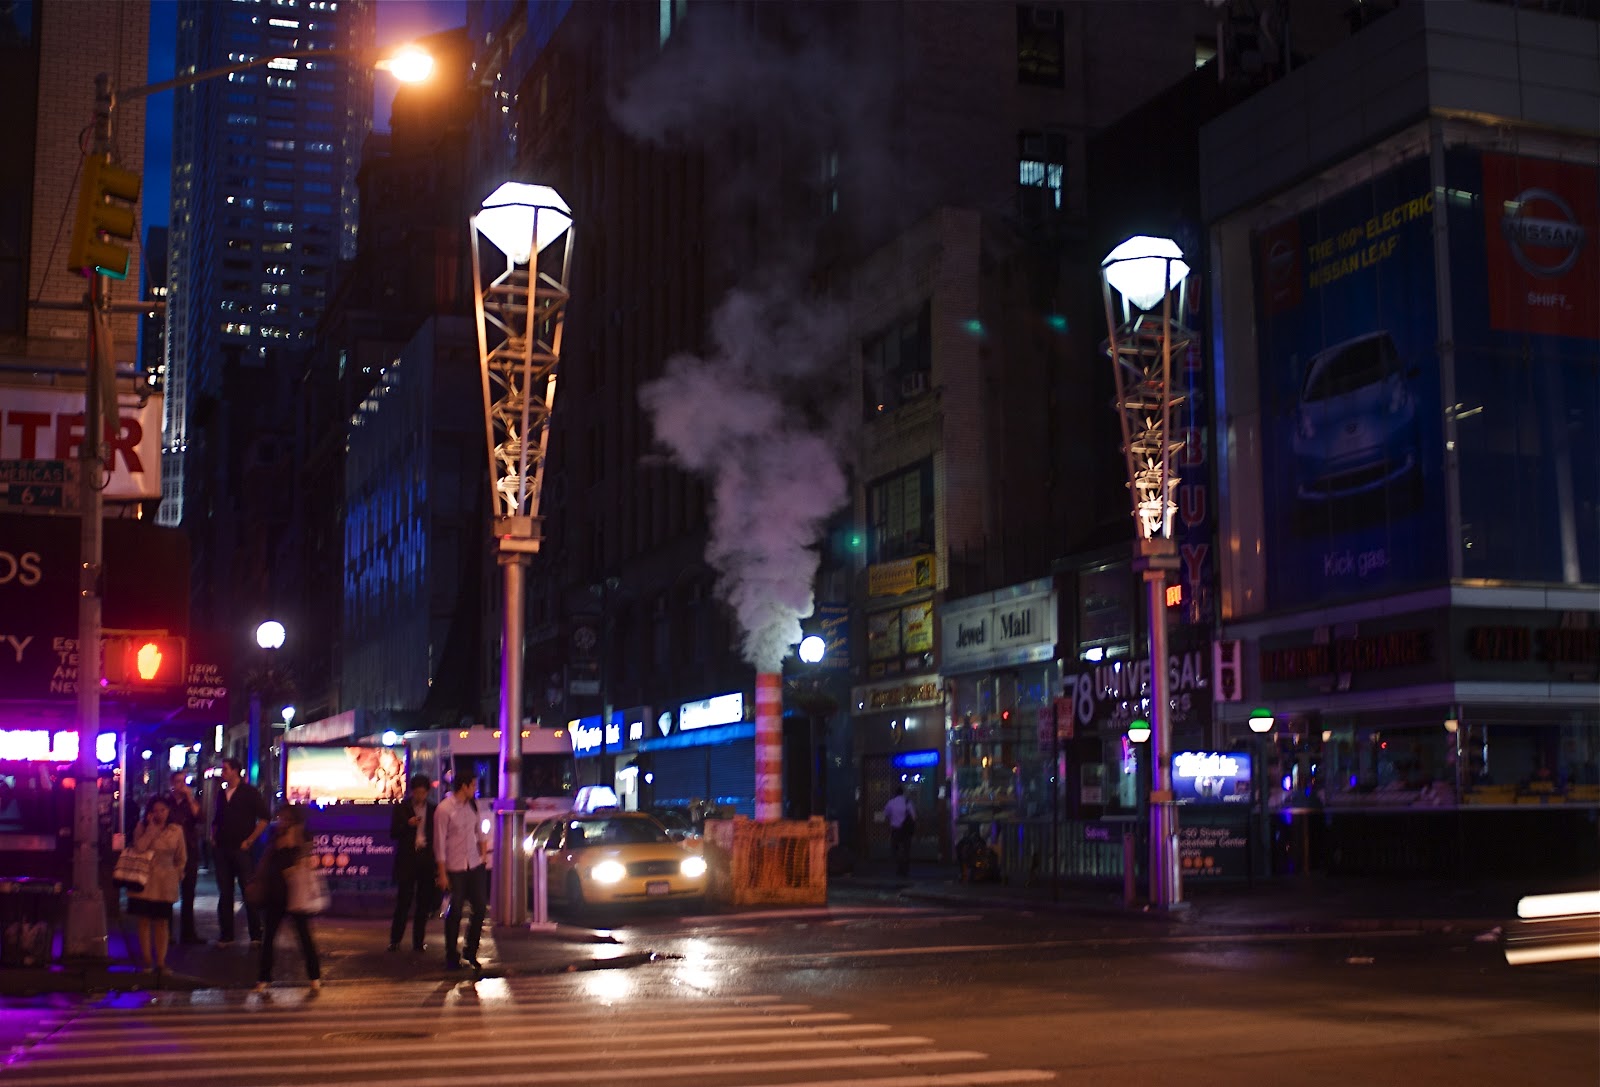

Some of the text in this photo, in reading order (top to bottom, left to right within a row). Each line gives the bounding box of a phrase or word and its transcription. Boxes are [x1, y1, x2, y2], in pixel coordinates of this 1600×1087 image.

[1308, 239, 1334, 265] THE
[1366, 191, 1434, 240] ELECTRIC
[1503, 221, 1580, 245] NISSAN
[1309, 234, 1399, 289] NISSAN LEAF
[0, 411, 145, 473] TER
[21, 485, 34, 504] 6
[1323, 549, 1355, 577] Kick
[956, 618, 986, 648] Jewel
[1000, 608, 1032, 641] Mall
[1063, 671, 1094, 726] 78
[1095, 651, 1208, 702] UNIVESAL
[332, 834, 374, 847] Streets
[366, 844, 395, 856] Station
